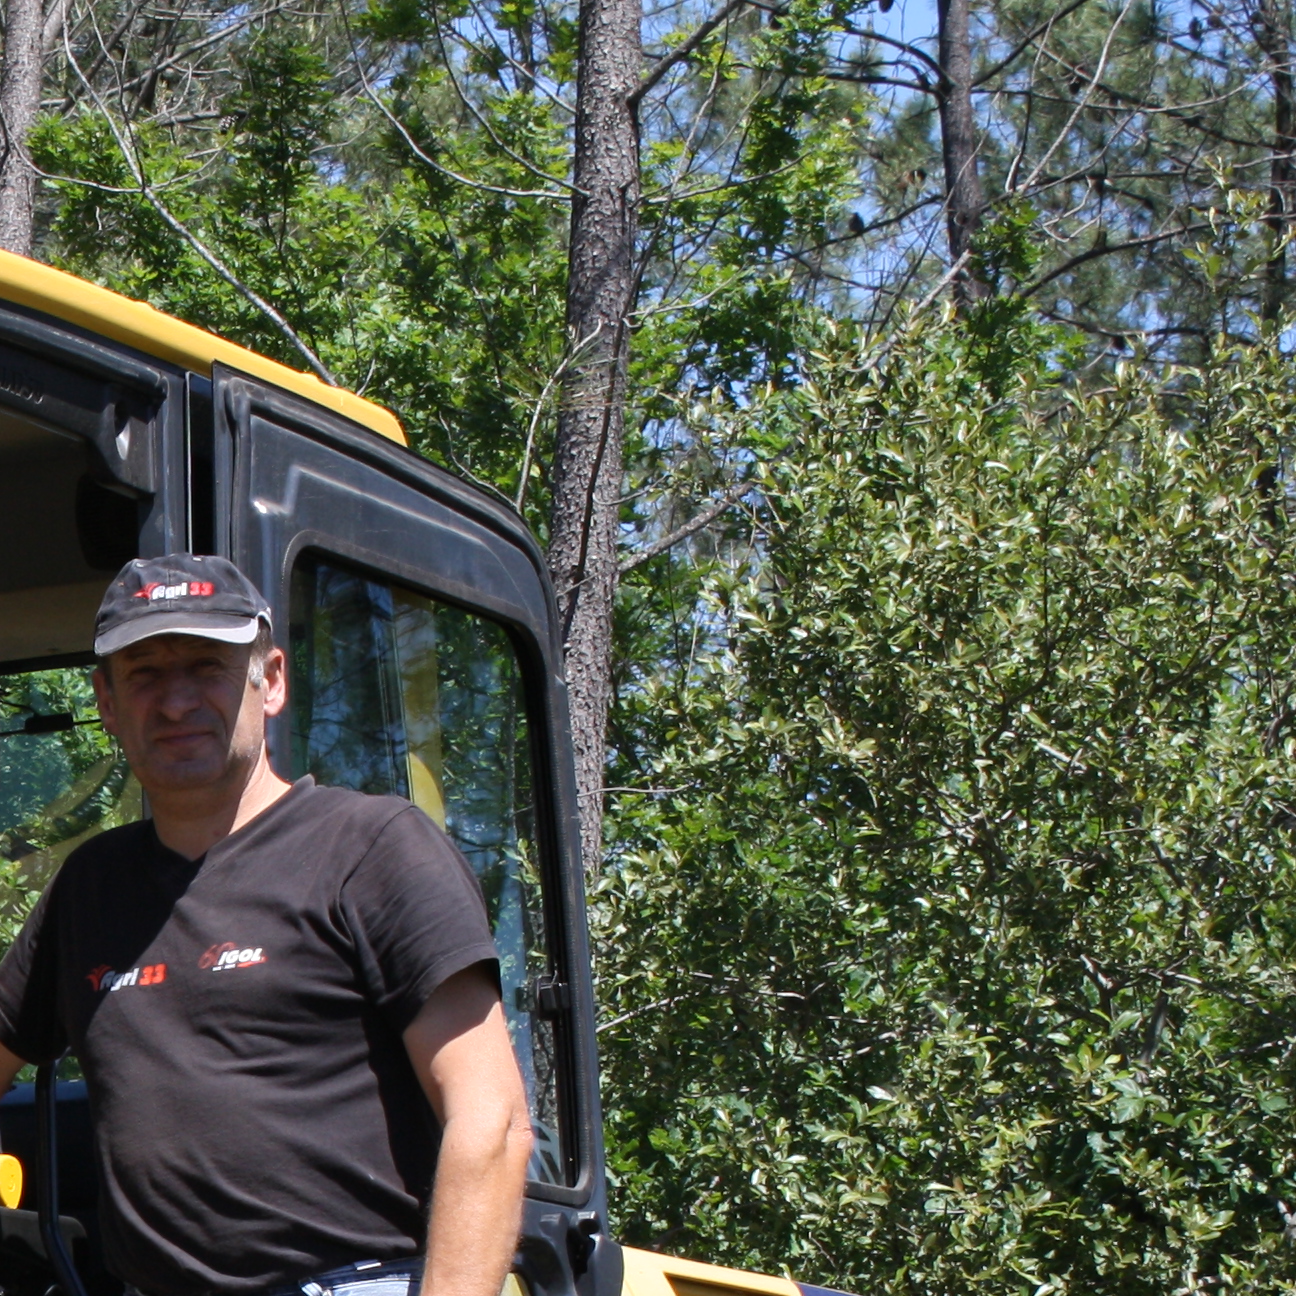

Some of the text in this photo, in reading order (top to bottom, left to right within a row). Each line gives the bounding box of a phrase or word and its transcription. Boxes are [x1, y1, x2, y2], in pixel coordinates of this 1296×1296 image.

[151, 581, 215, 600] Agri 33
[218, 948, 263, 965] IGOL
[100, 963, 168, 992] Agri 33
